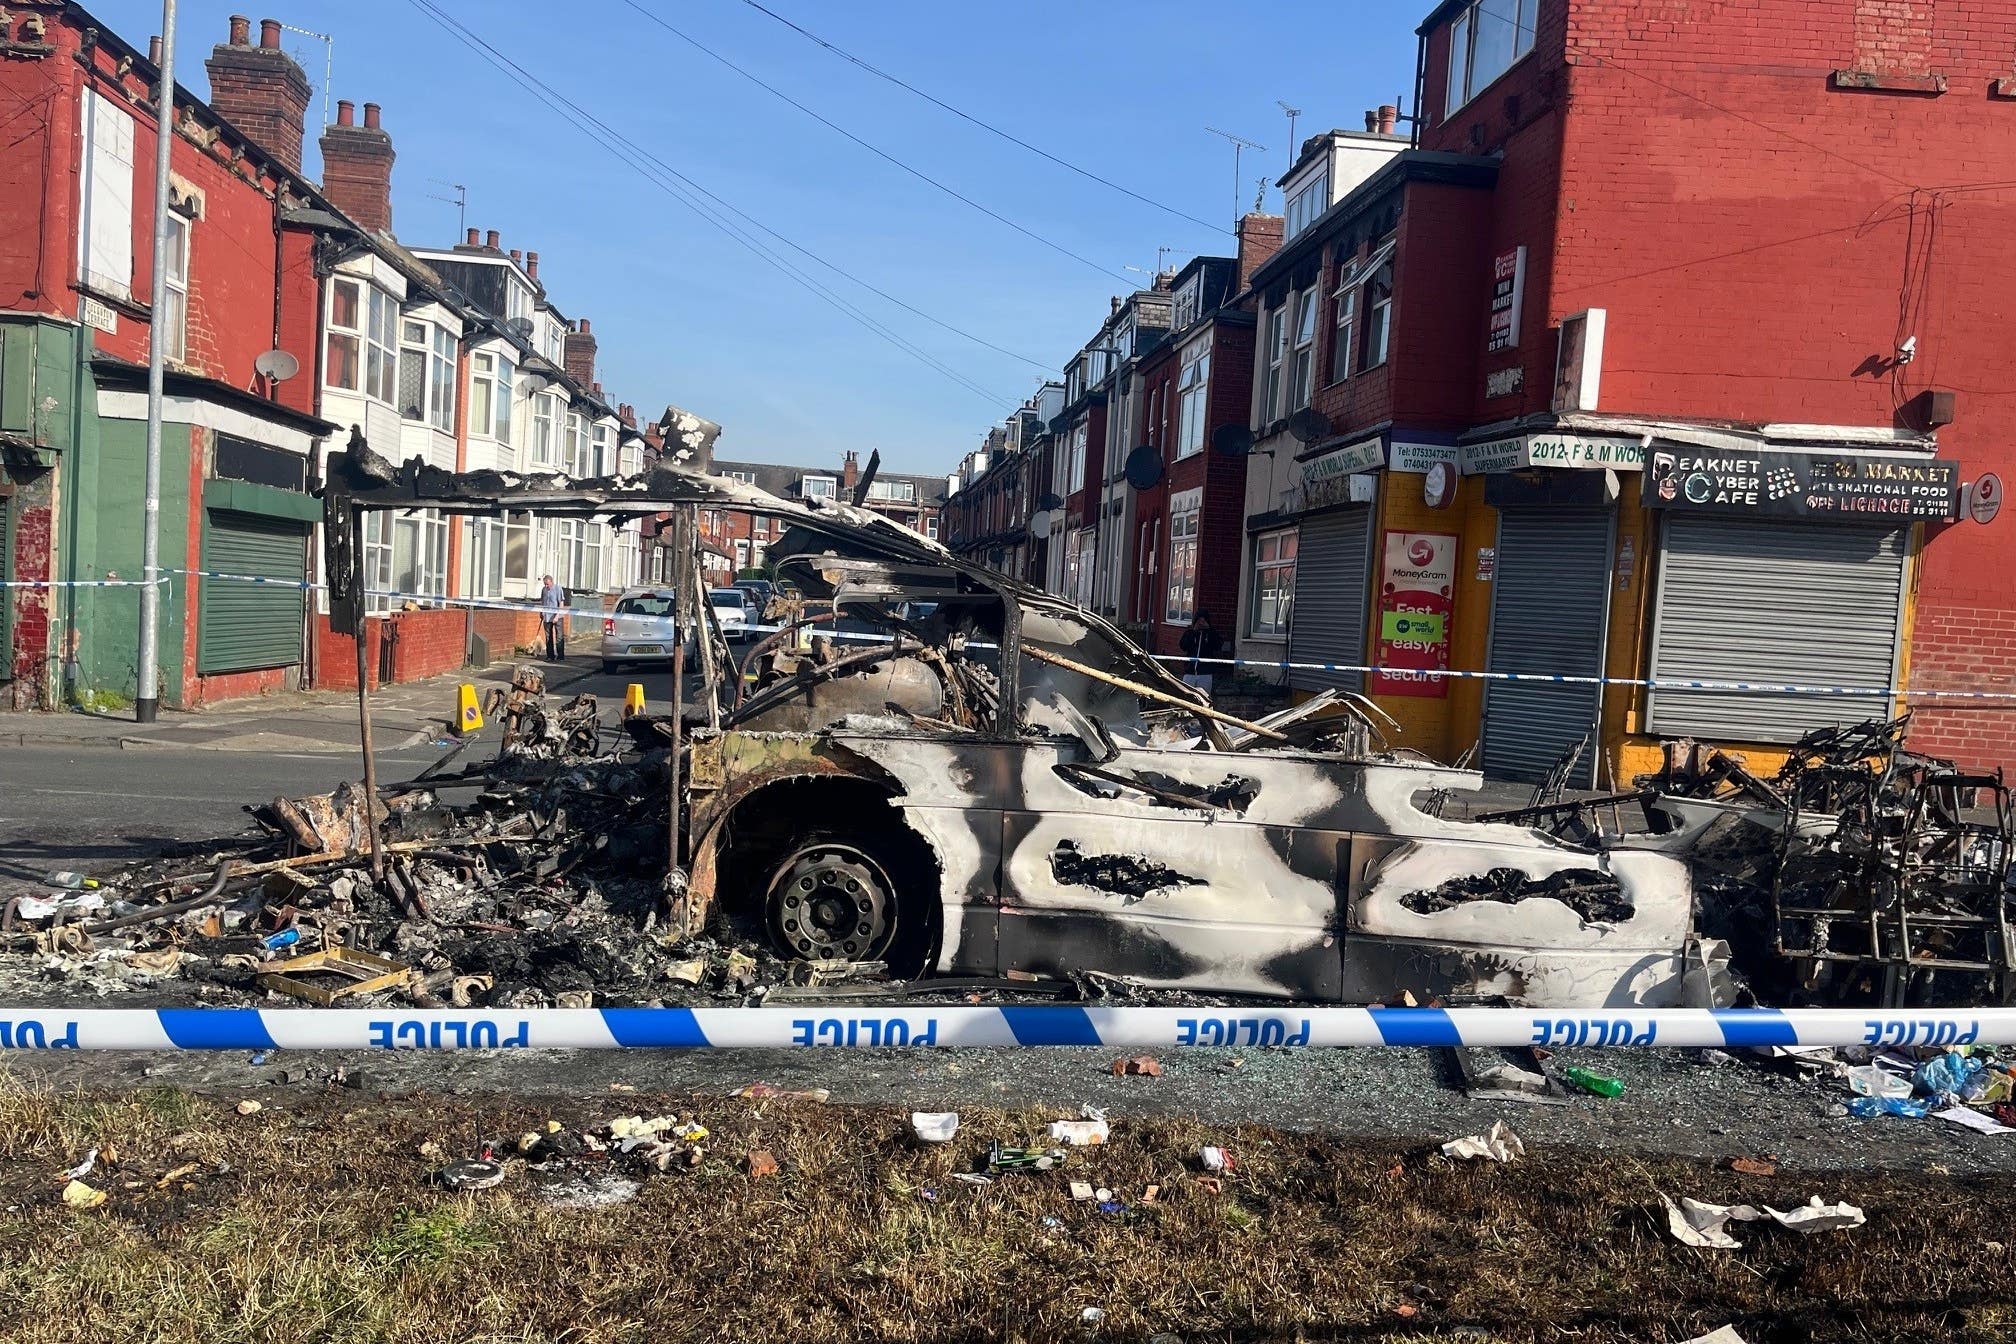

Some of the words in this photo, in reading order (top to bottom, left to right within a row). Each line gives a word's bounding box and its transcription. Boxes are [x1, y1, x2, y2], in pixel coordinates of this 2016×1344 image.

[1397, 446, 1410, 456] Tel:
[1492, 444, 1498, 454] M
[1499, 440, 1521, 453] WORLD
[1572, 444, 1581, 460] F
[1584, 444, 1594, 460] &
[1600, 445, 1611, 462] M
[1474, 455, 1518, 472] SUPERMARKET
[1864, 463, 1950, 483] MARKET
[1912, 486, 1948, 497] FOOD
[1392, 569, 1447, 580] MoneyGram
[1416, 626, 1435, 634] world
[1392, 639, 1435, 654] easy,
[1382, 669, 1441, 683] secure
[369, 1021, 530, 1049] POLICE
[792, 1019, 938, 1047] POLICE
[1175, 1019, 1311, 1047] POLICE
[1531, 1019, 1658, 1046] POLICE
[1857, 1019, 1980, 1046] POLICE
